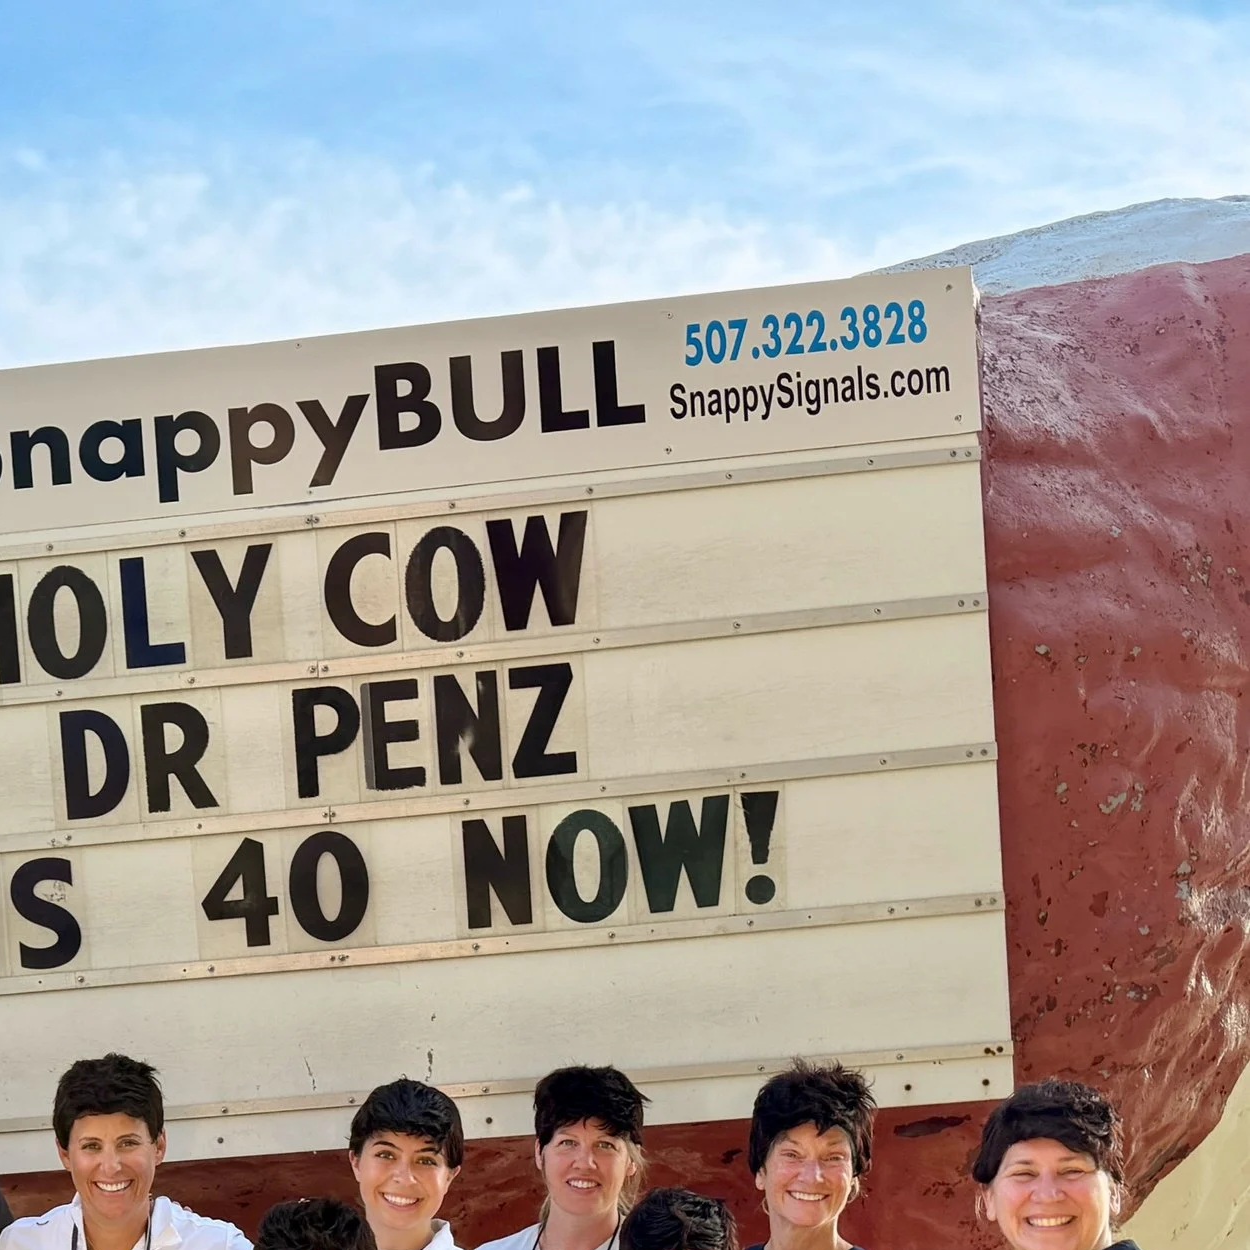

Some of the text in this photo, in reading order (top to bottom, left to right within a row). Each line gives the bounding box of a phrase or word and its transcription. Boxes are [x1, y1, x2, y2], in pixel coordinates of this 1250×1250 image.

[669, 365, 951, 424] SnappySignals.com
[684, 299, 928, 367] 507.322.3828
[324, 510, 588, 648] COW
[59, 662, 578, 821] DR PENZ
[201, 830, 370, 948] 40
[461, 790, 779, 930] NOW!
